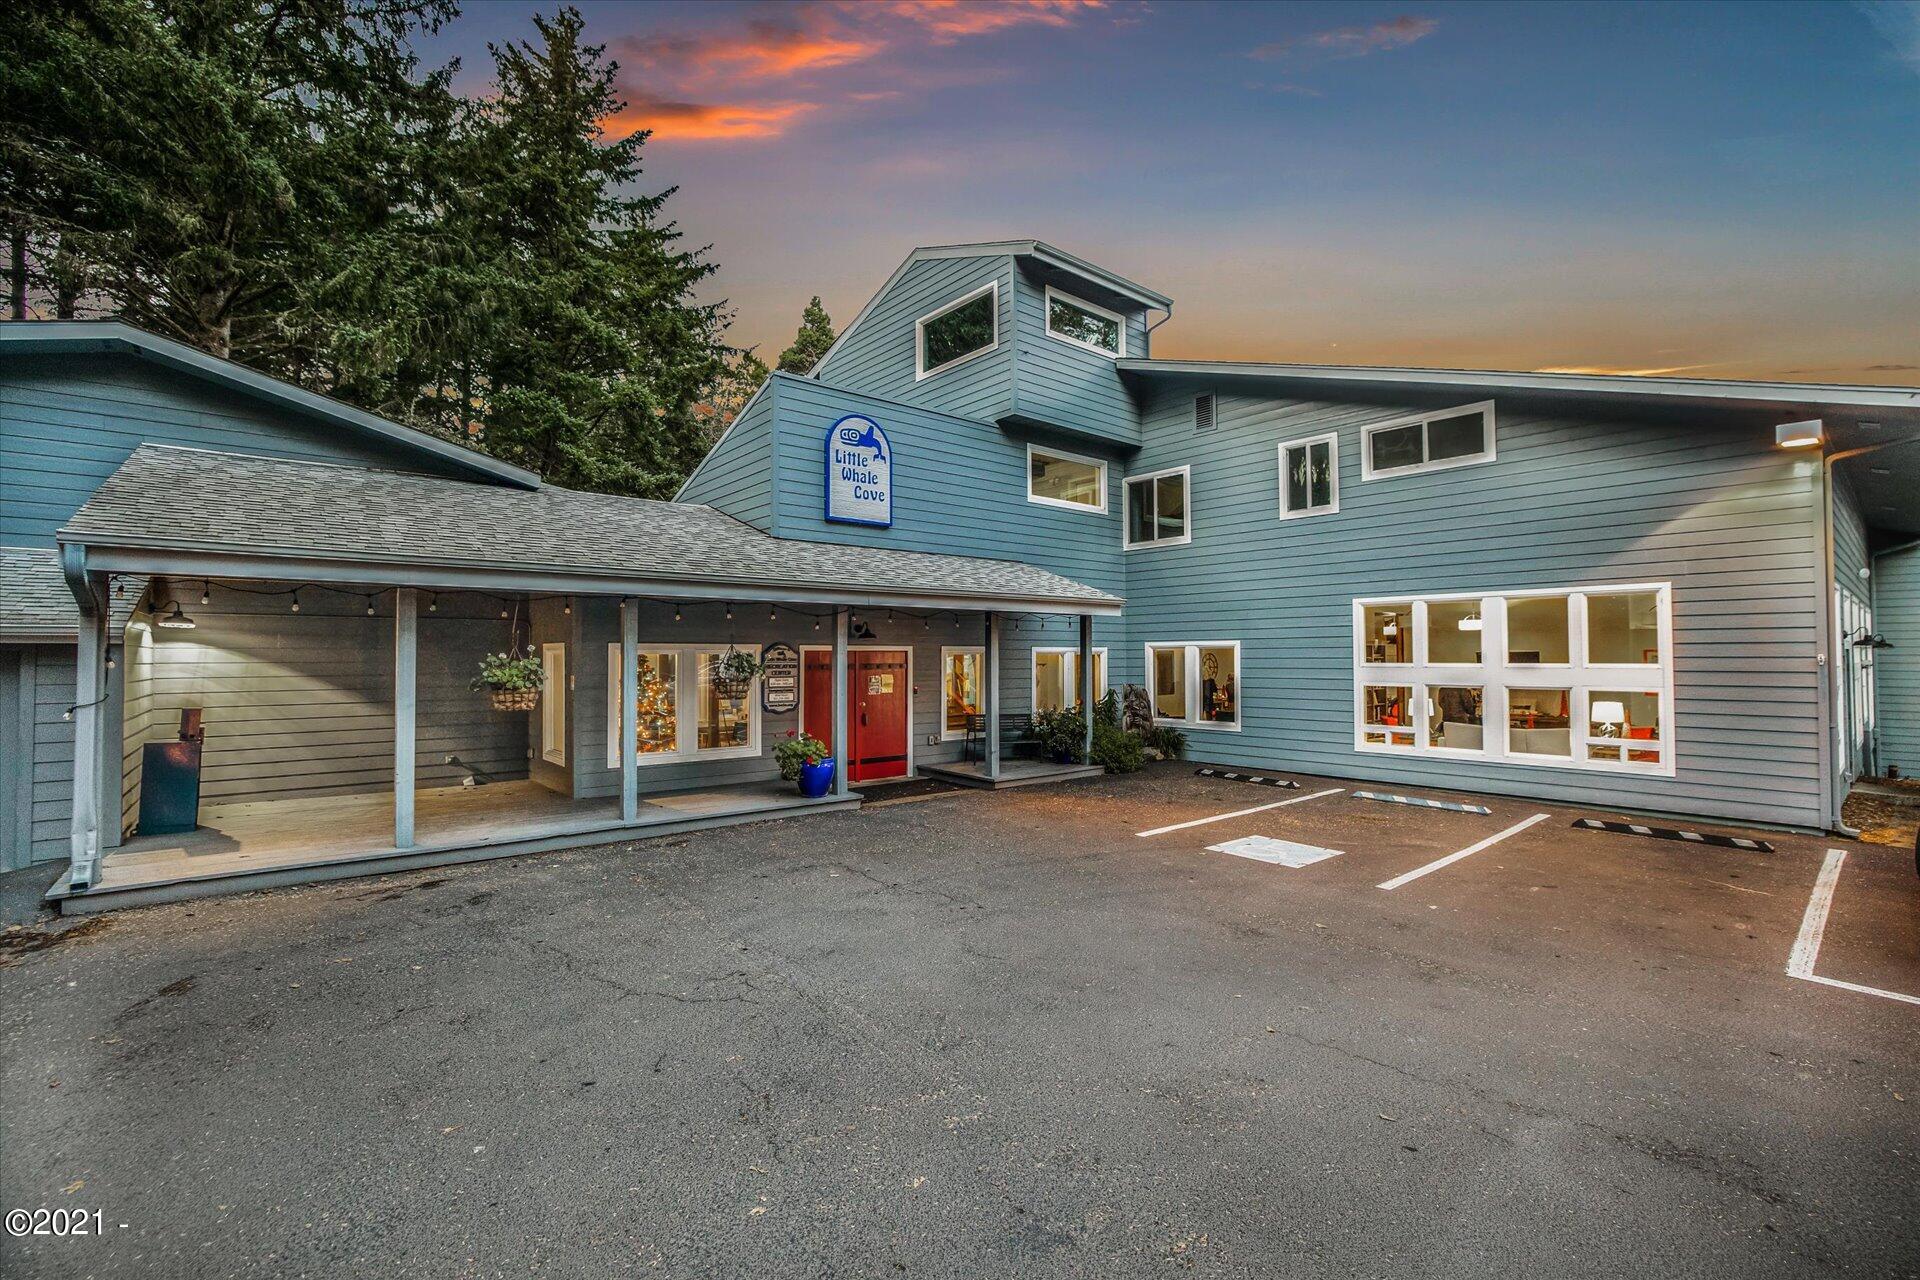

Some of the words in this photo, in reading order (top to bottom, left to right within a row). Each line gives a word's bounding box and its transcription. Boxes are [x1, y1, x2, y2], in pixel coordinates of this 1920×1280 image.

[835, 449, 868, 467] Little
[842, 467, 878, 485] Whale
[854, 485, 885, 502] Cove
